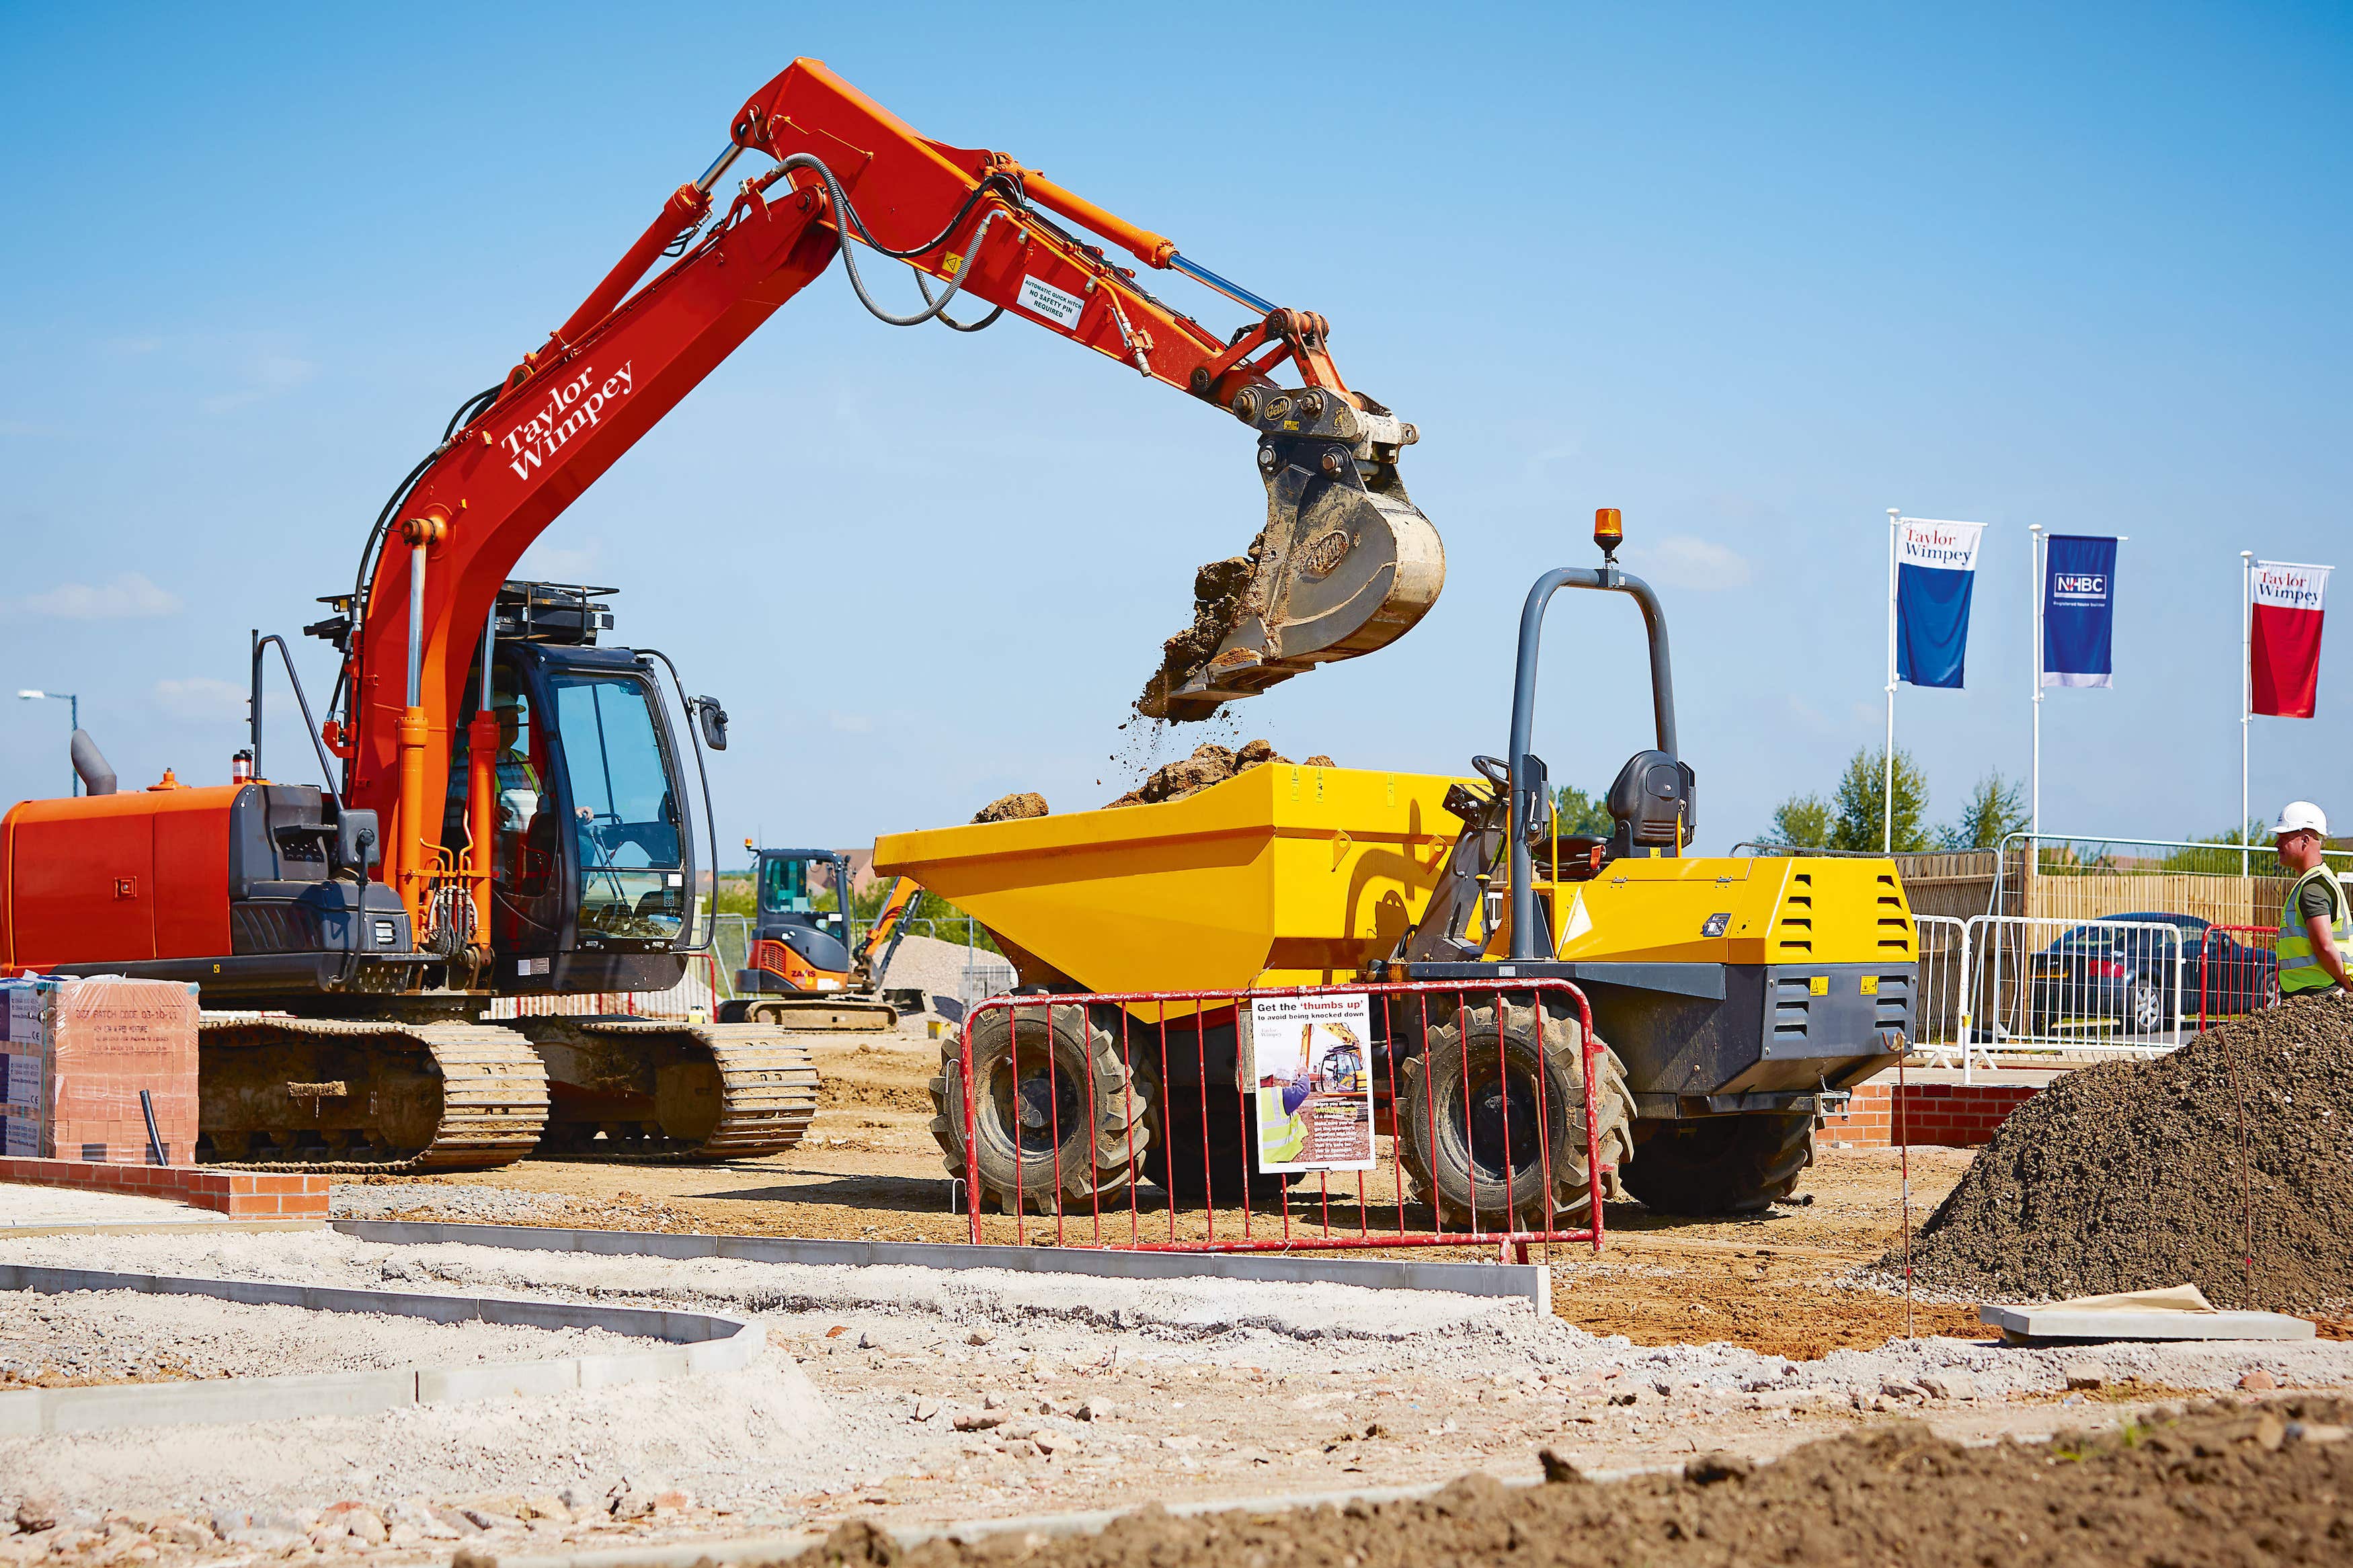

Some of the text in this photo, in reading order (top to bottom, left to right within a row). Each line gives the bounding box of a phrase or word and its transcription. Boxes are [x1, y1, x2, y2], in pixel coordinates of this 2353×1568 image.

[1025, 280, 1082, 309] AUTOMATIC QUICK HITCH
[1029, 289, 1073, 314] NO SAFETY PIN
[1034, 300, 1064, 318] REQUIRED
[501, 366, 592, 458] Taylor
[509, 360, 632, 481] Wimpey
[1905, 529, 1956, 546] Taylor
[1906, 542, 1972, 566] Wimpey
[2058, 577, 2103, 592] NHBC
[2260, 571, 2307, 588] Taylor
[2260, 583, 2317, 605] Wimpey
[1257, 1003, 1276, 1012] Get
[1280, 1003, 1297, 1011] the
